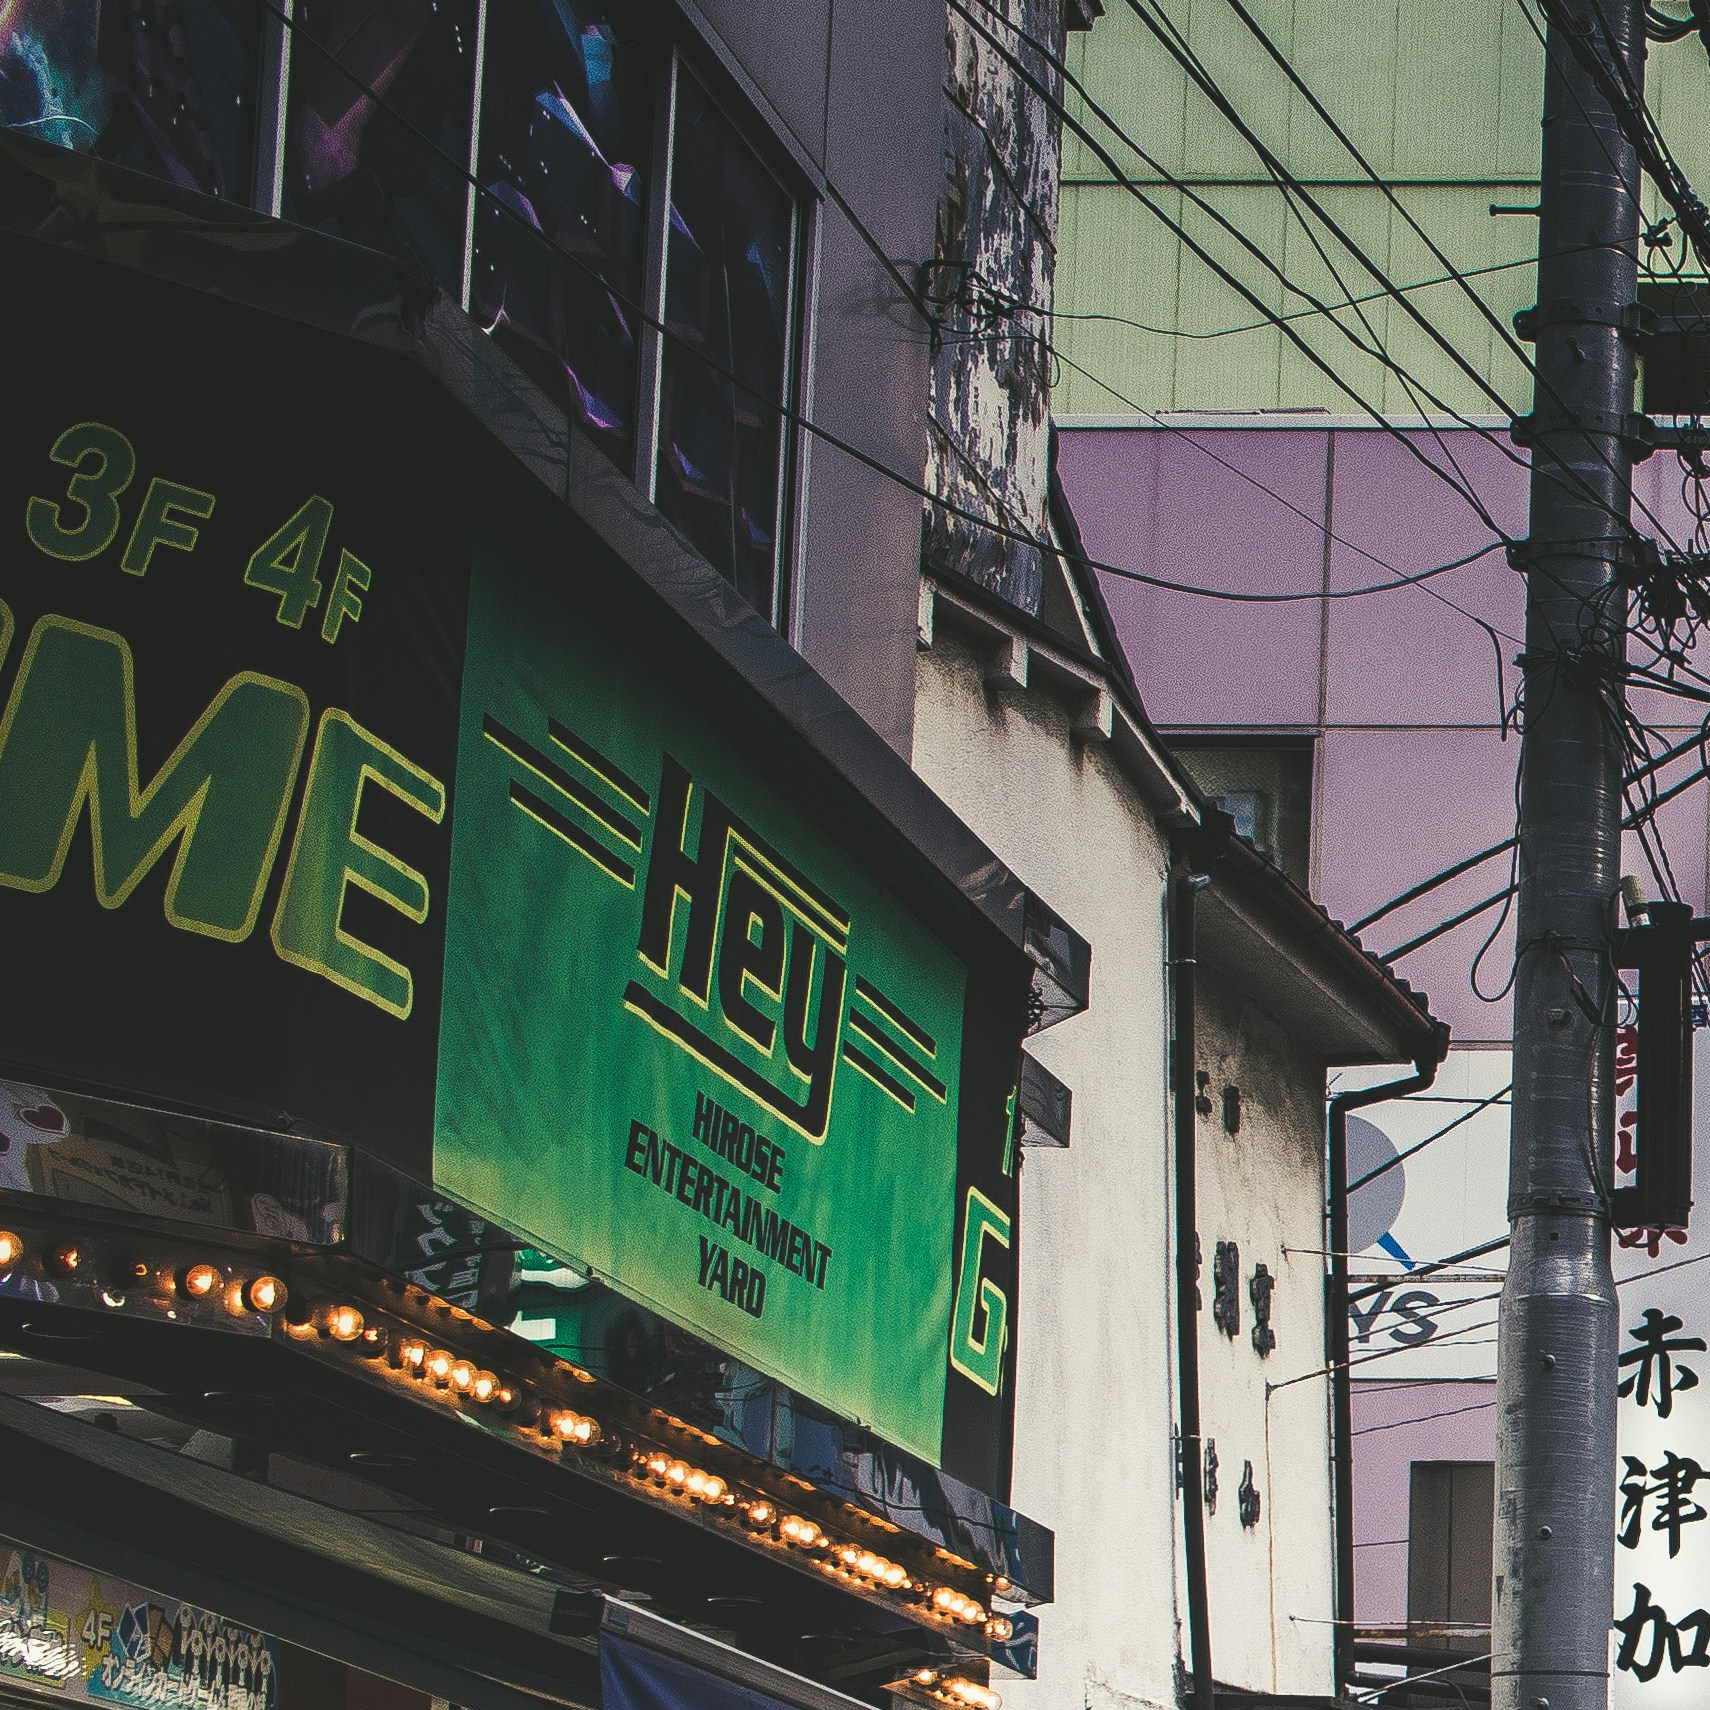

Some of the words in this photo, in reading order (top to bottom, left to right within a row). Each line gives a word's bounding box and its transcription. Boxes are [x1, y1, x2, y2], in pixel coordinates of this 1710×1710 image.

[26, 421, 216, 577] 3F
[243, 494, 373, 644] 4F
[0, 611, 447, 1022] ME
[620, 752, 853, 1145] Hey
[621, 1118, 834, 1292] ENTERTAINMENT
[691, 1089, 787, 1195] HIROSE
[698, 1237, 768, 1321] YARD
[82, 1608, 113, 1651] 4F
